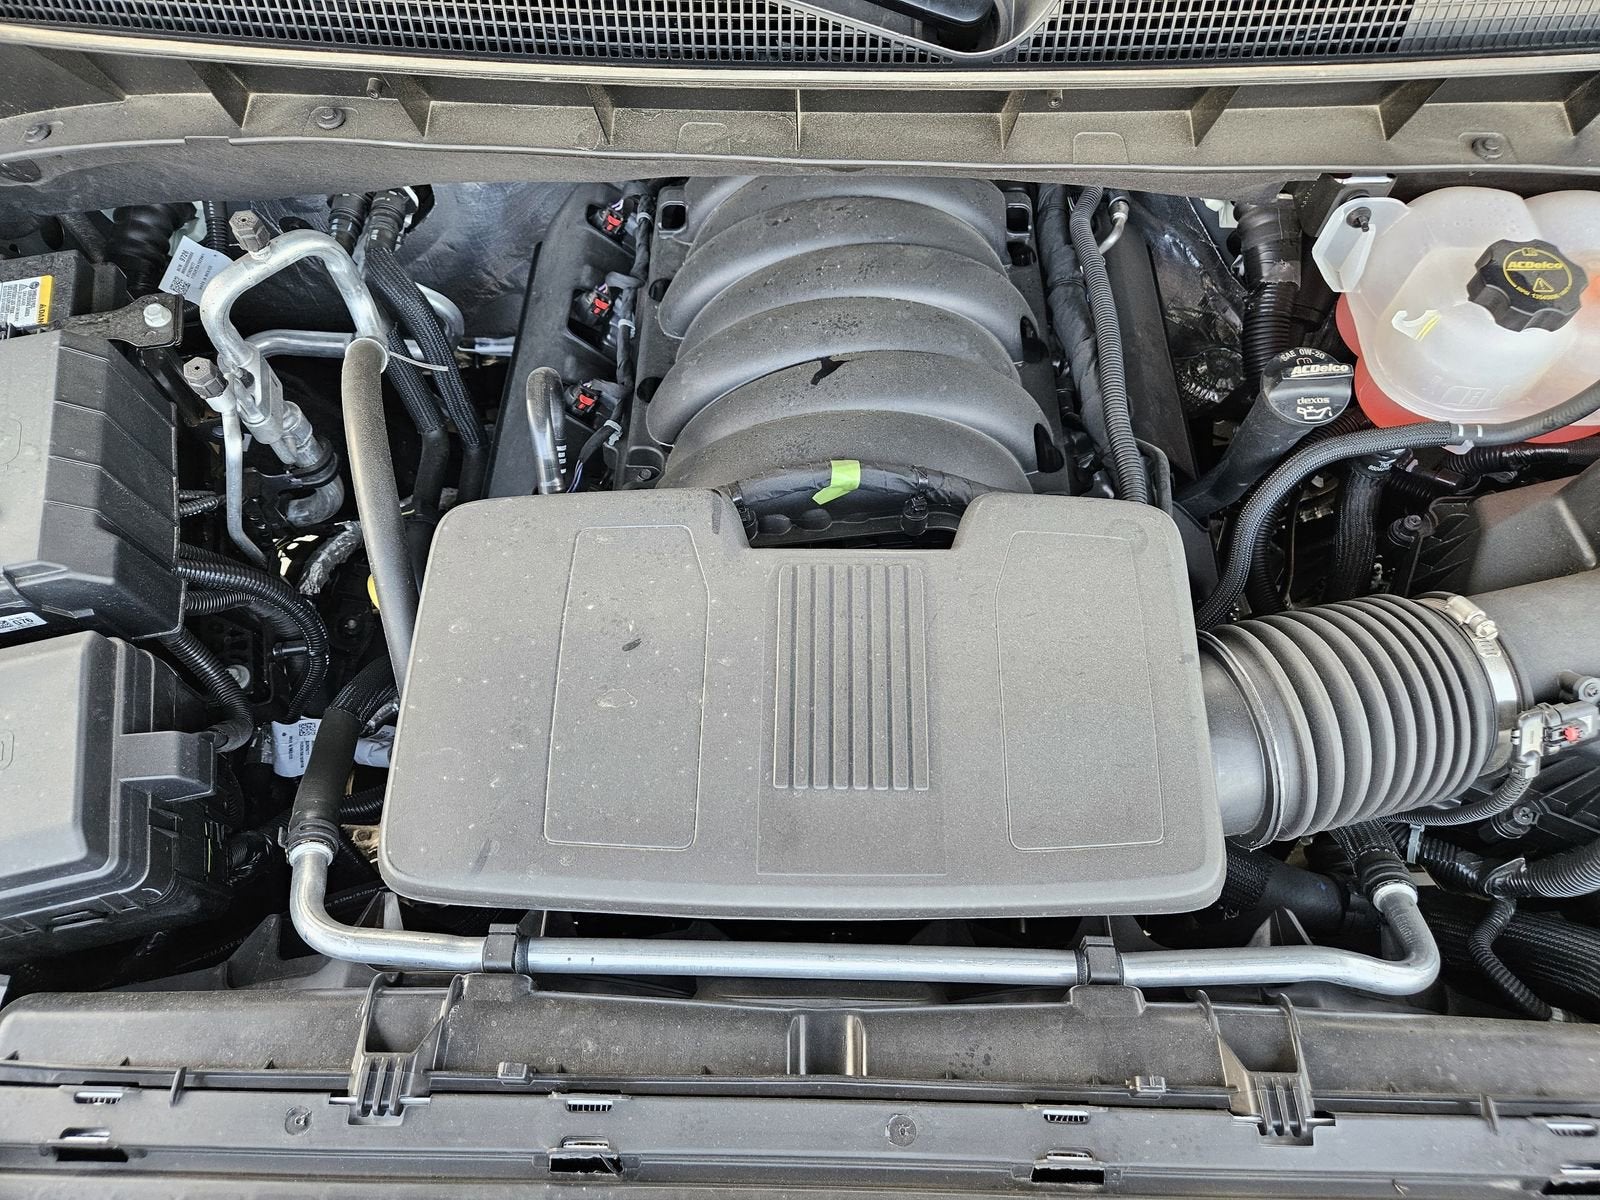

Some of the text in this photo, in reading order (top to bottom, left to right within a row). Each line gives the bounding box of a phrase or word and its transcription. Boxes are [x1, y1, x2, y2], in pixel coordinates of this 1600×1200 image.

[1507, 261, 1563, 269] ACDelco
[1280, 348, 1325, 361] SAE 0W-20
[1291, 363, 1349, 375] ACDelco
